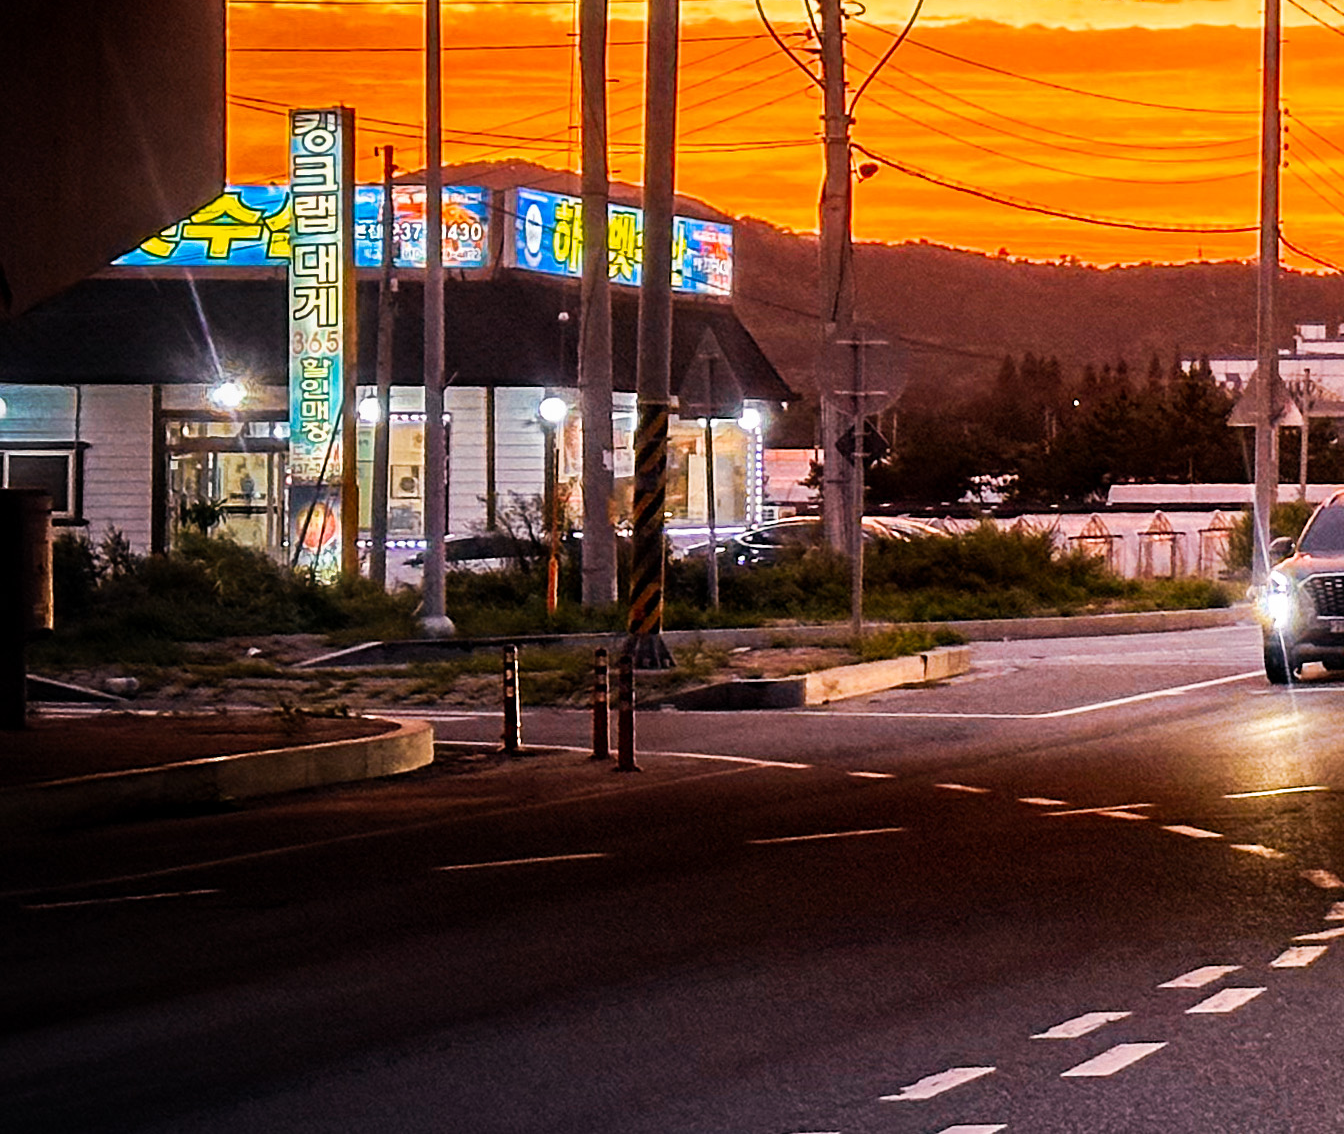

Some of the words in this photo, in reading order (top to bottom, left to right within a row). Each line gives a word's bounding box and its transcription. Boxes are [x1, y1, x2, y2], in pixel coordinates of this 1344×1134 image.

[292, 111, 340, 234] 킹크랩
[293, 243, 338, 327] 대게
[292, 330, 339, 354] 365
[301, 357, 334, 443] 할인매장
